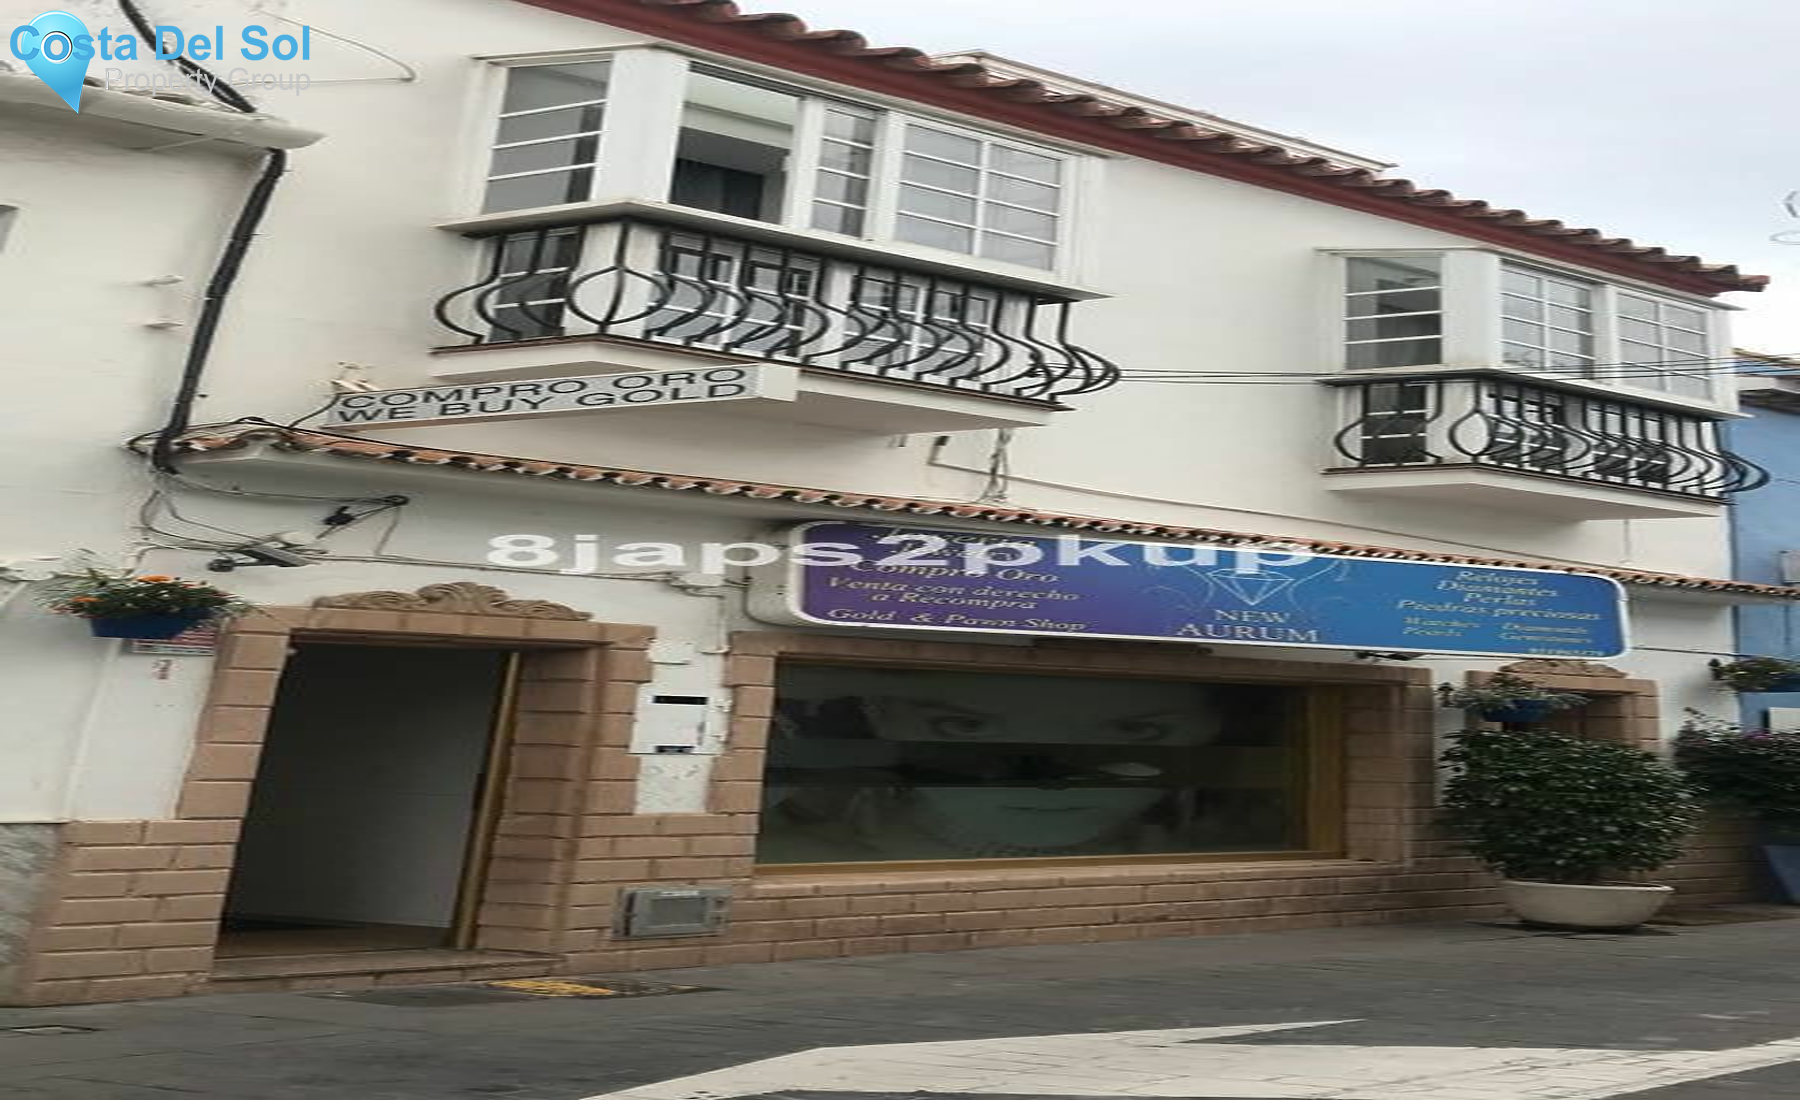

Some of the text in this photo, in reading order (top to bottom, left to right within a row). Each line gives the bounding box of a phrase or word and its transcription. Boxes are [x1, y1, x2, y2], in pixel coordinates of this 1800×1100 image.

[341, 368, 746, 409] COMPRO ORO
[337, 382, 745, 423] WE BUY GOLD
[997, 568, 1060, 583] Oro
[829, 577, 1081, 601] Venta con derecho
[871, 593, 1038, 610] a Recompra
[828, 608, 1088, 632] Gold & Pawn Shop
[1214, 609, 1291, 623] NEW
[1176, 623, 1318, 642] AURUM
